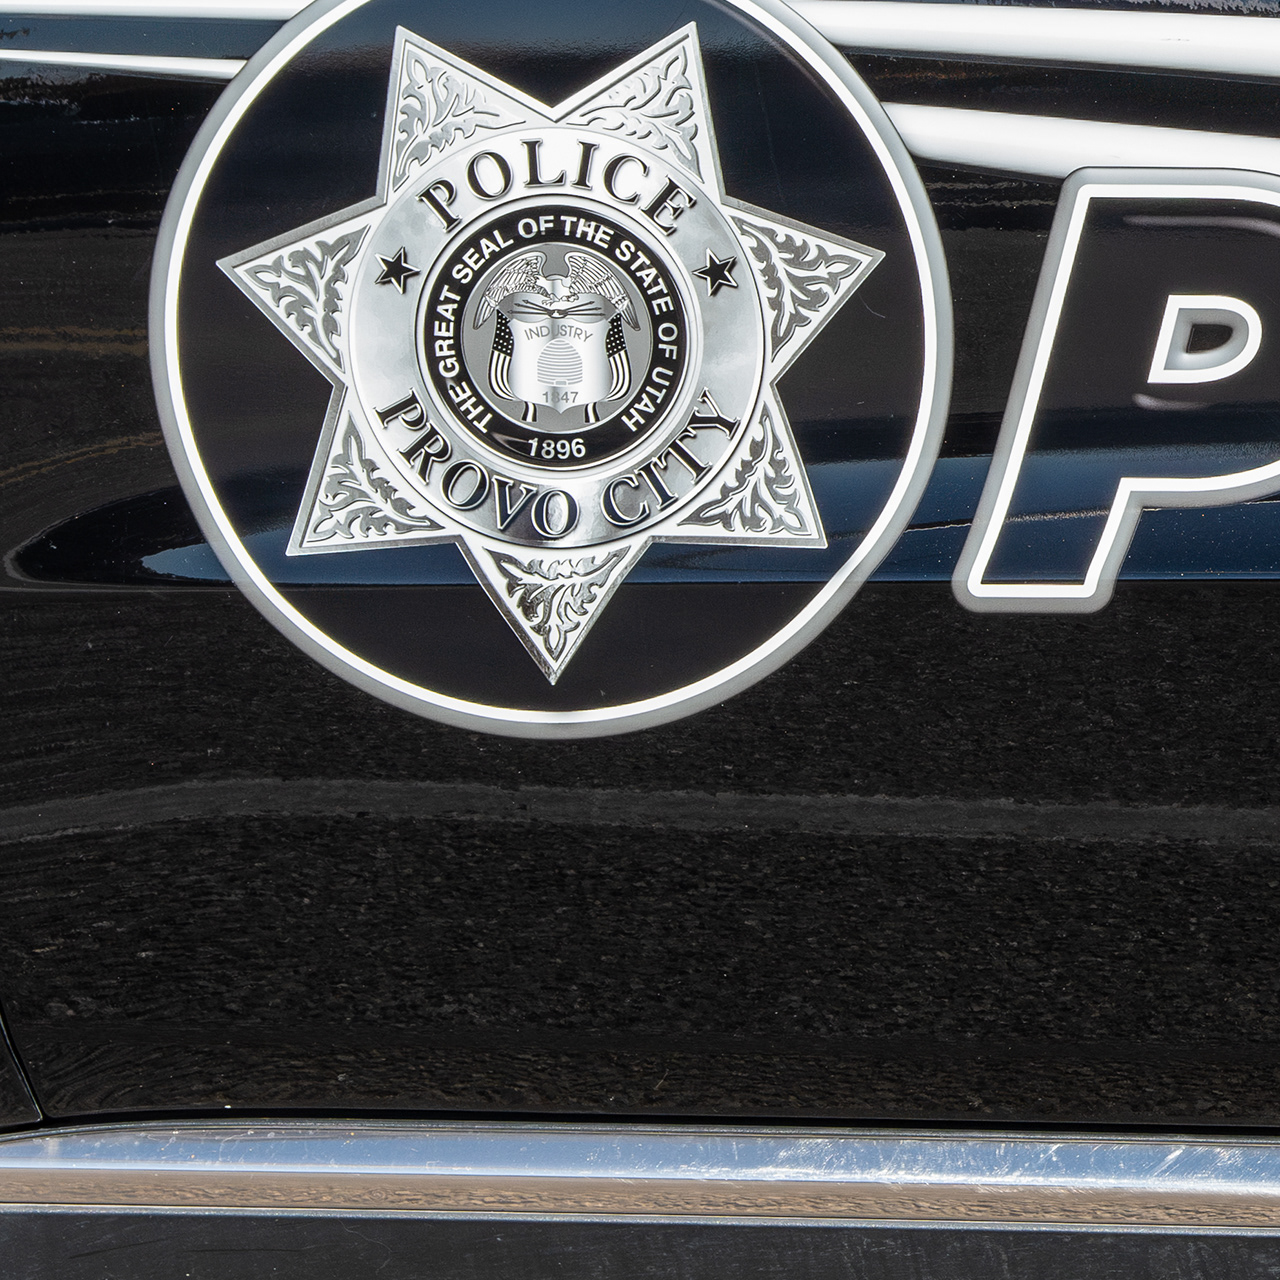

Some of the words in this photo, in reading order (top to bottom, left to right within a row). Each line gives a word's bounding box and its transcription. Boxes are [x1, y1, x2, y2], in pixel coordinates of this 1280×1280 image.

[414, 137, 698, 237] POLICE
[517, 215, 555, 239] OF
[560, 215, 615, 249] THE
[451, 229, 515, 285] SEAL
[614, 239, 675, 316] STATE
[433, 284, 462, 379] GREAT
[523, 323, 594, 343] INDUSTRY
[657, 322, 679, 361] OF
[448, 381, 493, 434] THE
[541, 390, 580, 404] 1847
[620, 366, 674, 433] UTAH
[372, 386, 580, 539] PROVO
[599, 386, 742, 527] CITY
[527, 436, 587, 460] 1896
